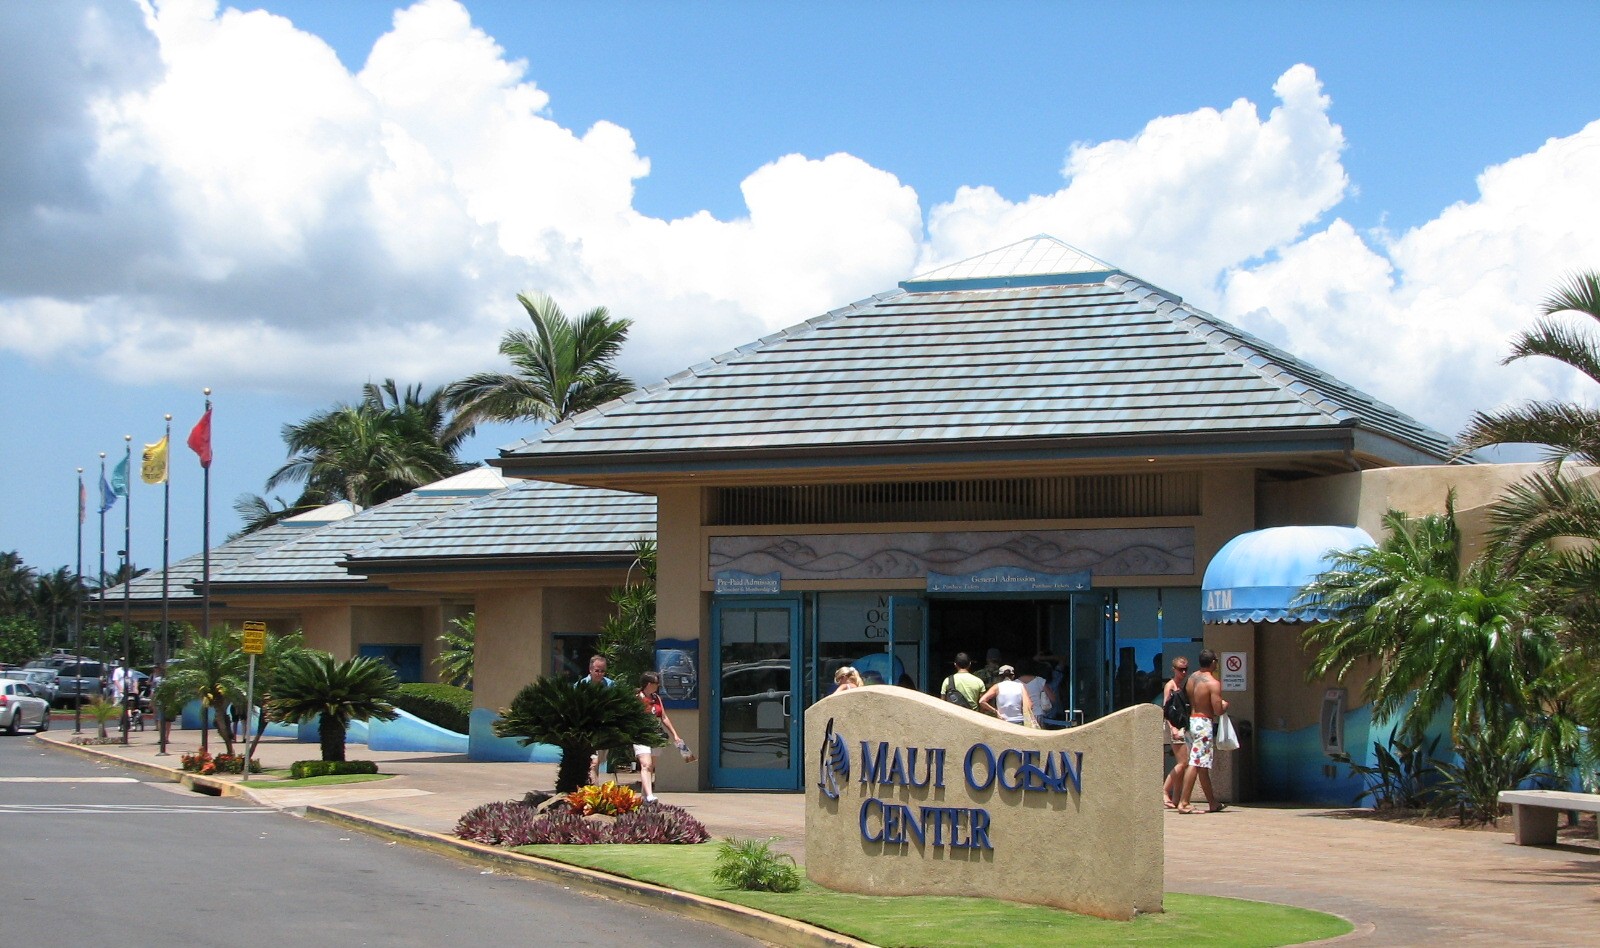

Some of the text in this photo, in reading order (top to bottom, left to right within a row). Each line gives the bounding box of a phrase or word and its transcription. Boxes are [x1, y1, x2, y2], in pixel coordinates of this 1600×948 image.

[717, 578, 778, 586] Pre-Paid Admission
[971, 575, 1036, 583] General Admission
[1207, 590, 1232, 611] ATM
[858, 740, 1083, 794] MAUI OCEAN
[859, 797, 994, 850] CENTER
